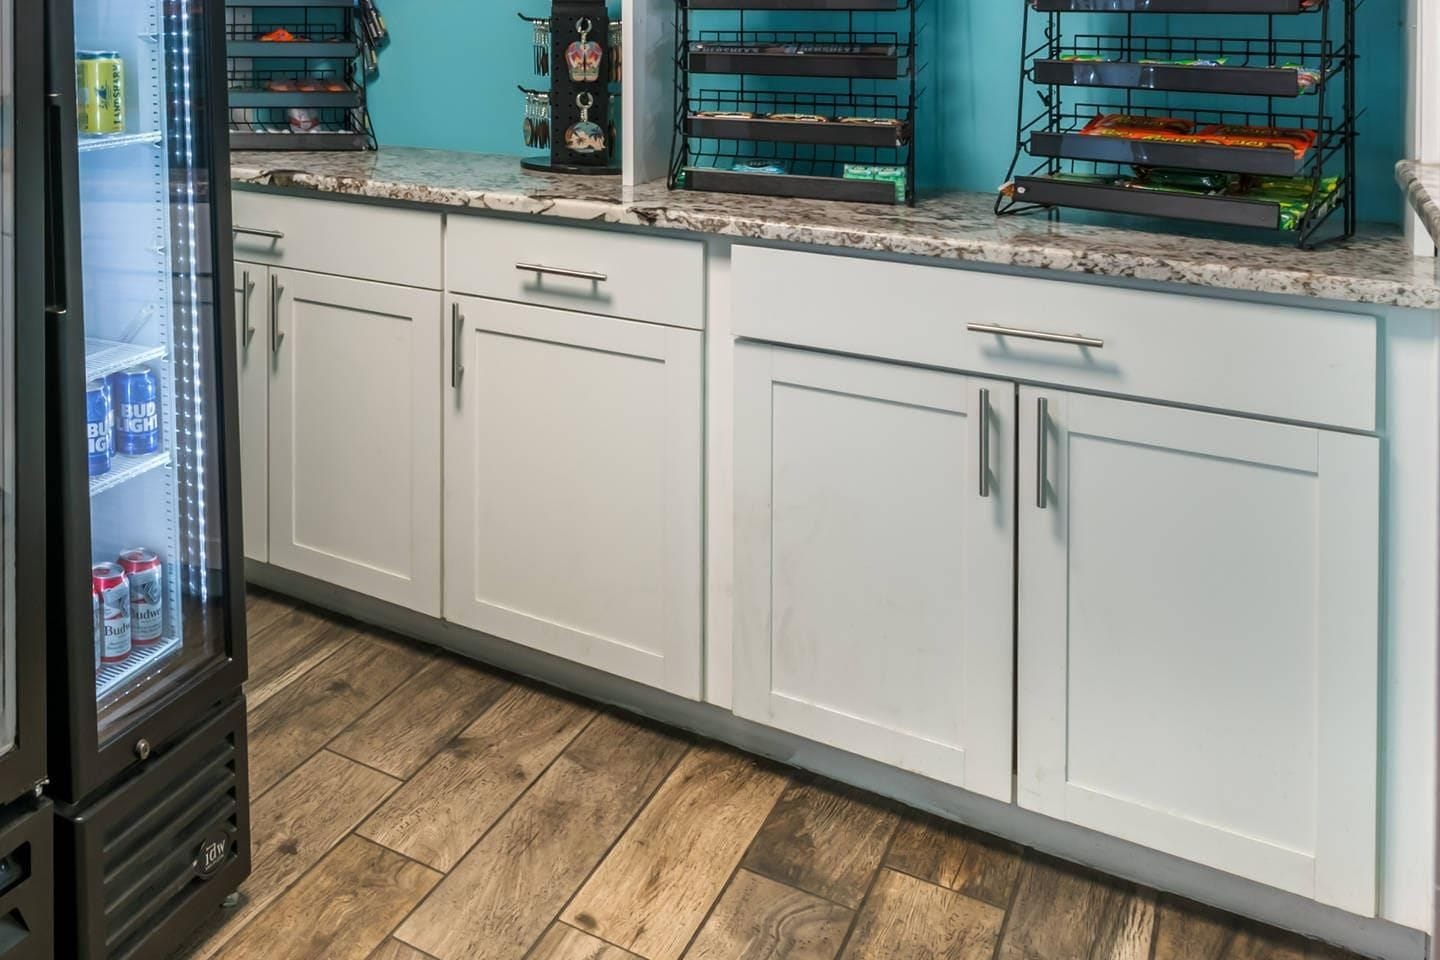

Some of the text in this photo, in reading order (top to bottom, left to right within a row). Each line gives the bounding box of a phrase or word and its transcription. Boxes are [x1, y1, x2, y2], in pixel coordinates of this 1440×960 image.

[121, 401, 156, 418] BUD
[87, 422, 107, 437] BU
[116, 414, 158, 433] LIGHT
